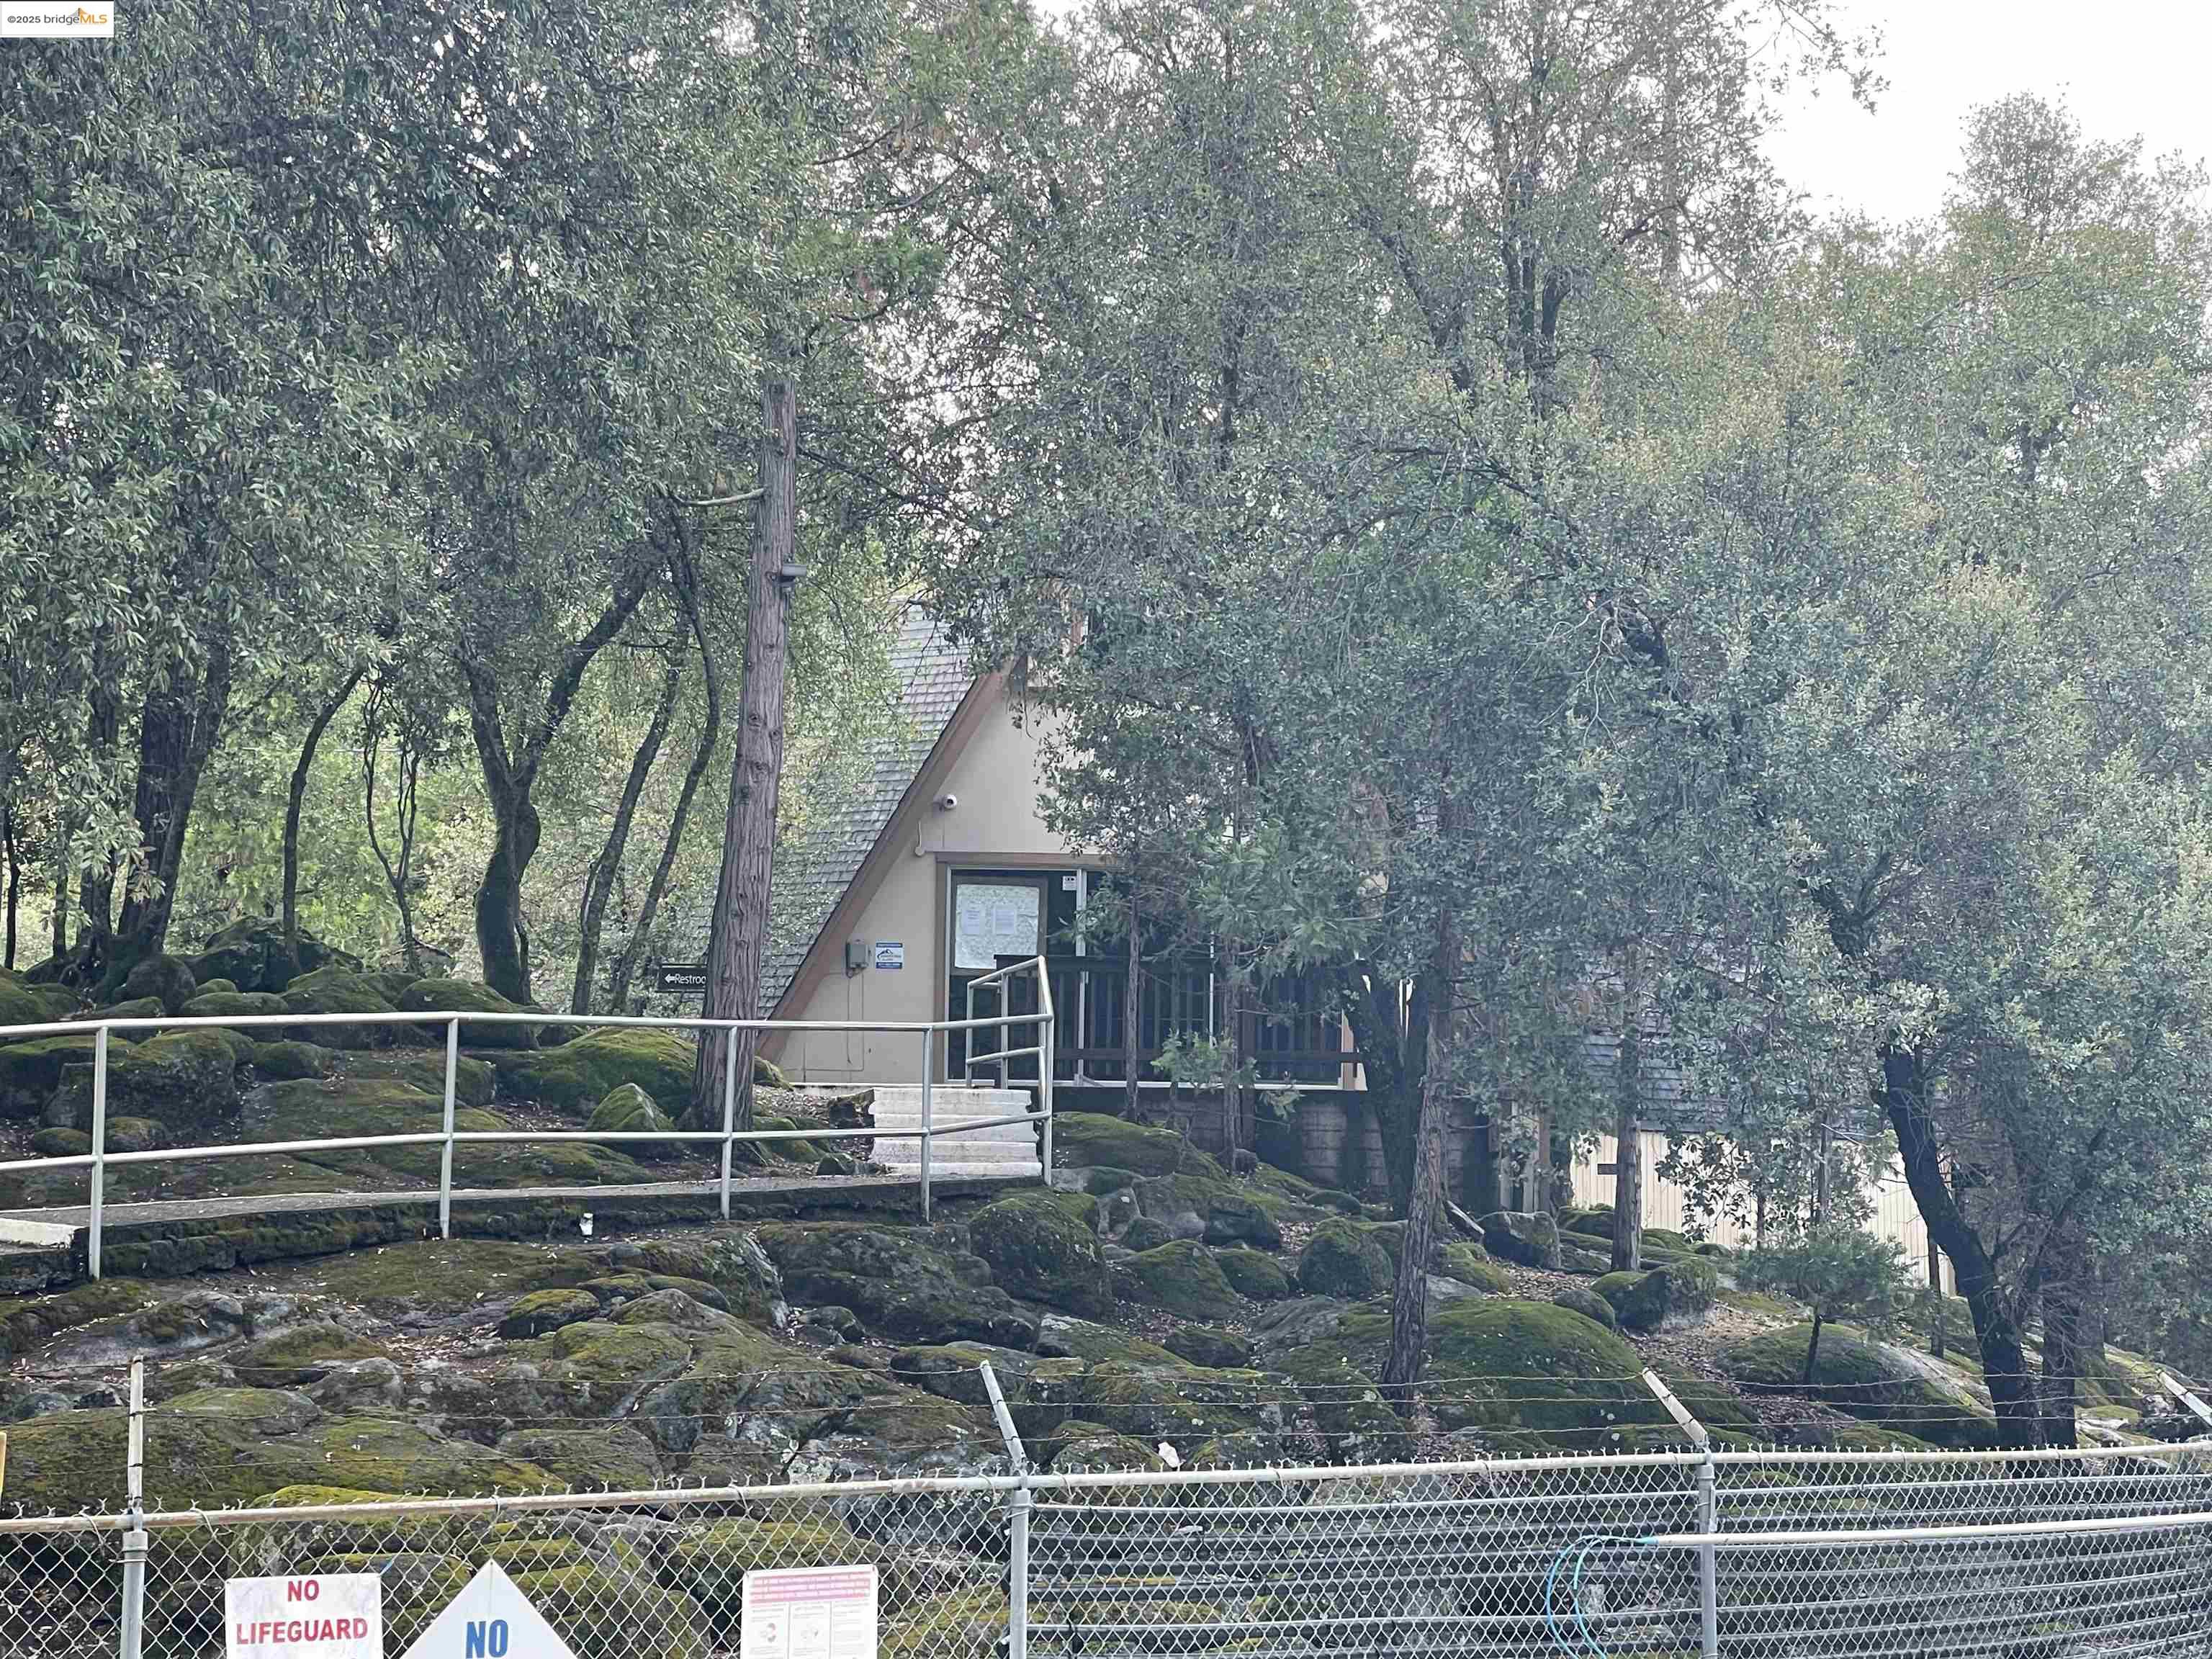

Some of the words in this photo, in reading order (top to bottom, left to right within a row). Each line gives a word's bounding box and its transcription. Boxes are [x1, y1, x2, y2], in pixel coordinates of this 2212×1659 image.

[675, 973, 706, 984] Restroo
[287, 1579, 320, 1602] NO
[236, 1618, 368, 1645] LIFEGUARD
[466, 1619, 508, 1658] NO
